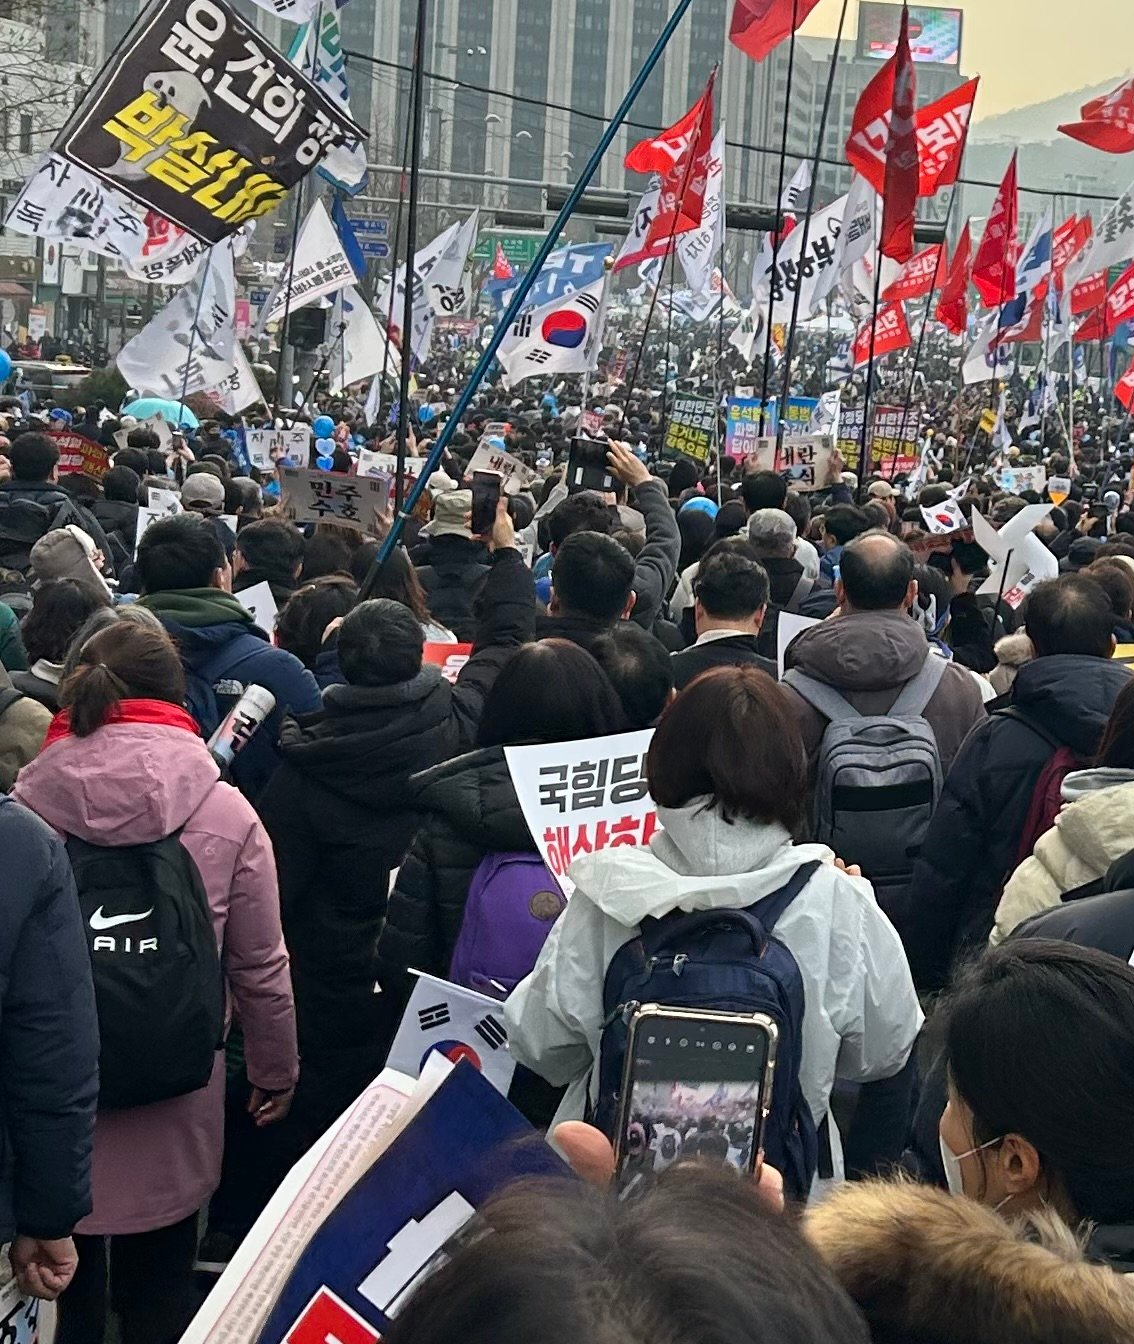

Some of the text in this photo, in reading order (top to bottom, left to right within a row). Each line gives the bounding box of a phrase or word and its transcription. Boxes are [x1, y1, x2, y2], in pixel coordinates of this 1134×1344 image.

[674, 399, 716, 416] 대한민국
[308, 480, 363, 500] 민주
[308, 499, 362, 524] 수호
[539, 752, 649, 814] 국힘당
[94, 936, 159, 954] AIR
